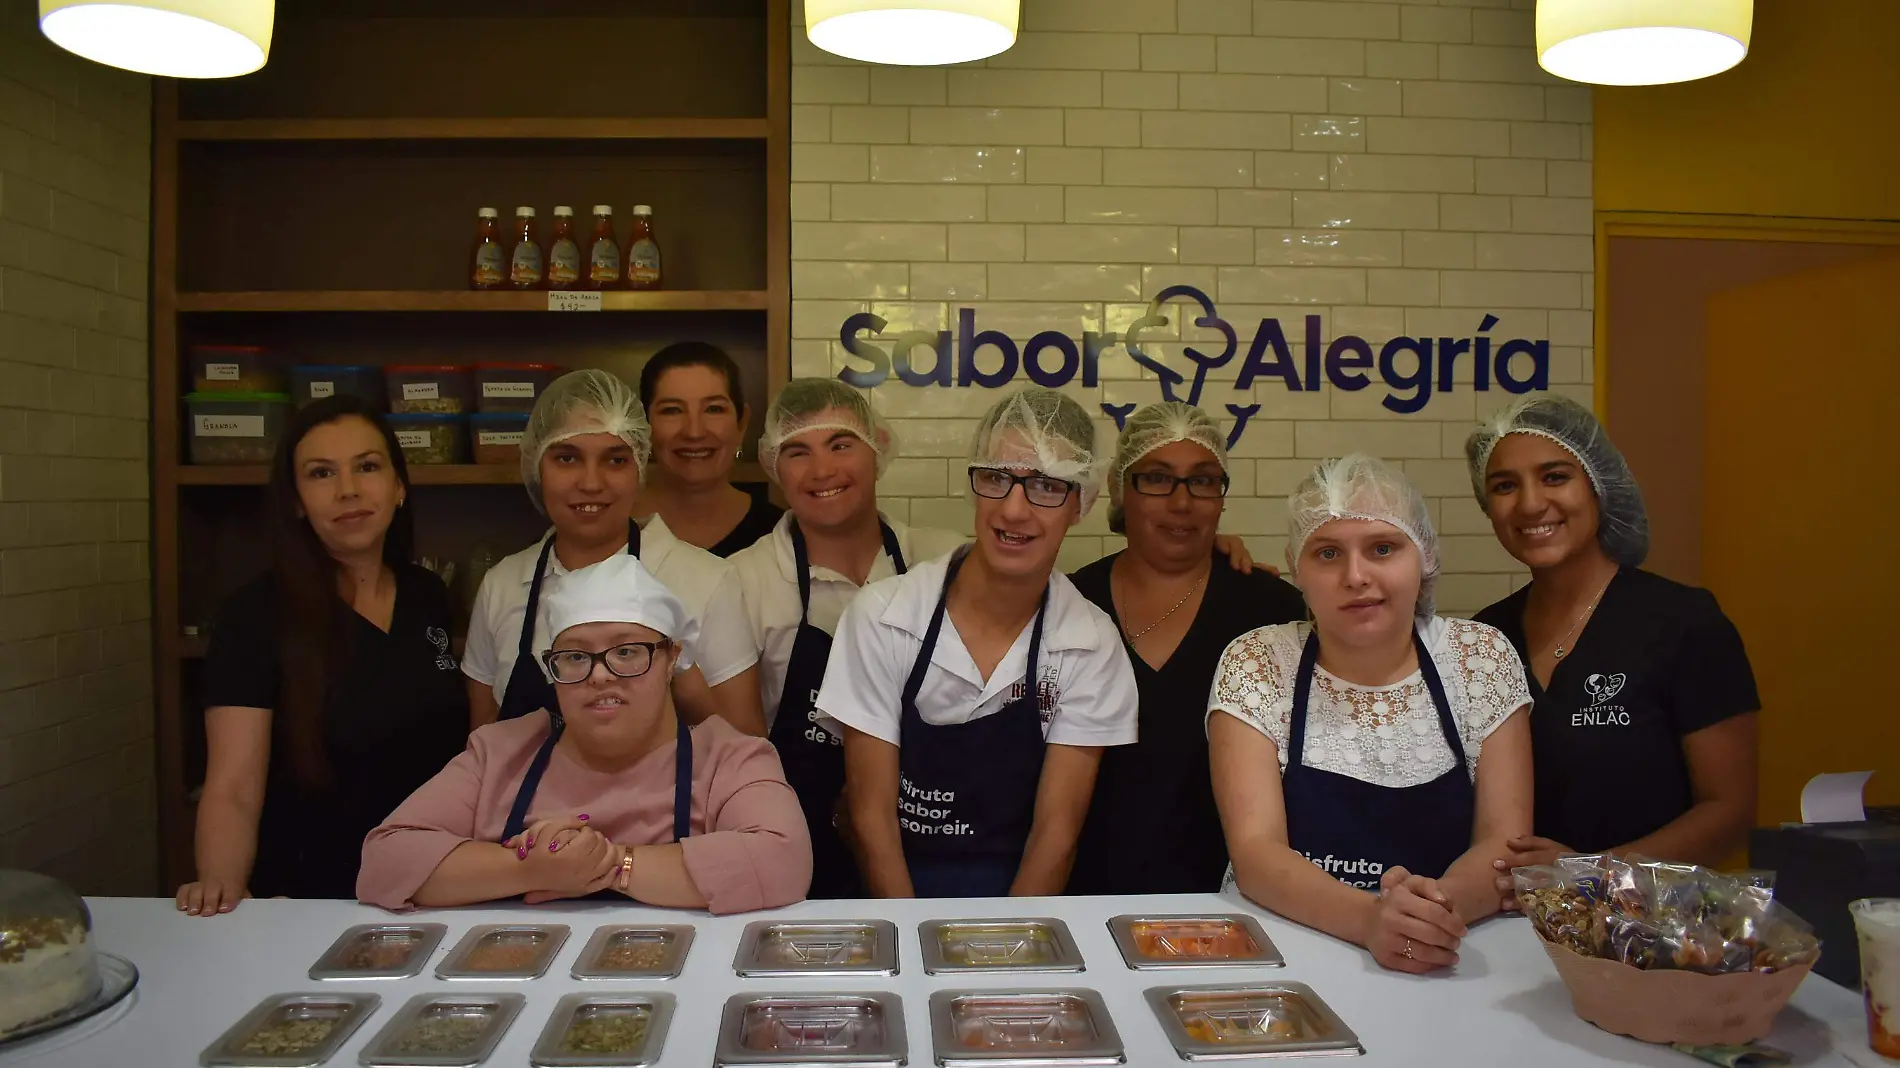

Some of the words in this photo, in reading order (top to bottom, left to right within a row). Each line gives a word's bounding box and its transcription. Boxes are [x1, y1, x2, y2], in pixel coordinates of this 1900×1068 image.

[837, 307, 1117, 389] Sabor
[1234, 313, 1550, 414] Alegría
[1579, 705, 1625, 713] INSTITUTO
[1571, 711, 1631, 726] ENLAC
[804, 726, 827, 743] de
[898, 796, 952, 820] sabor
